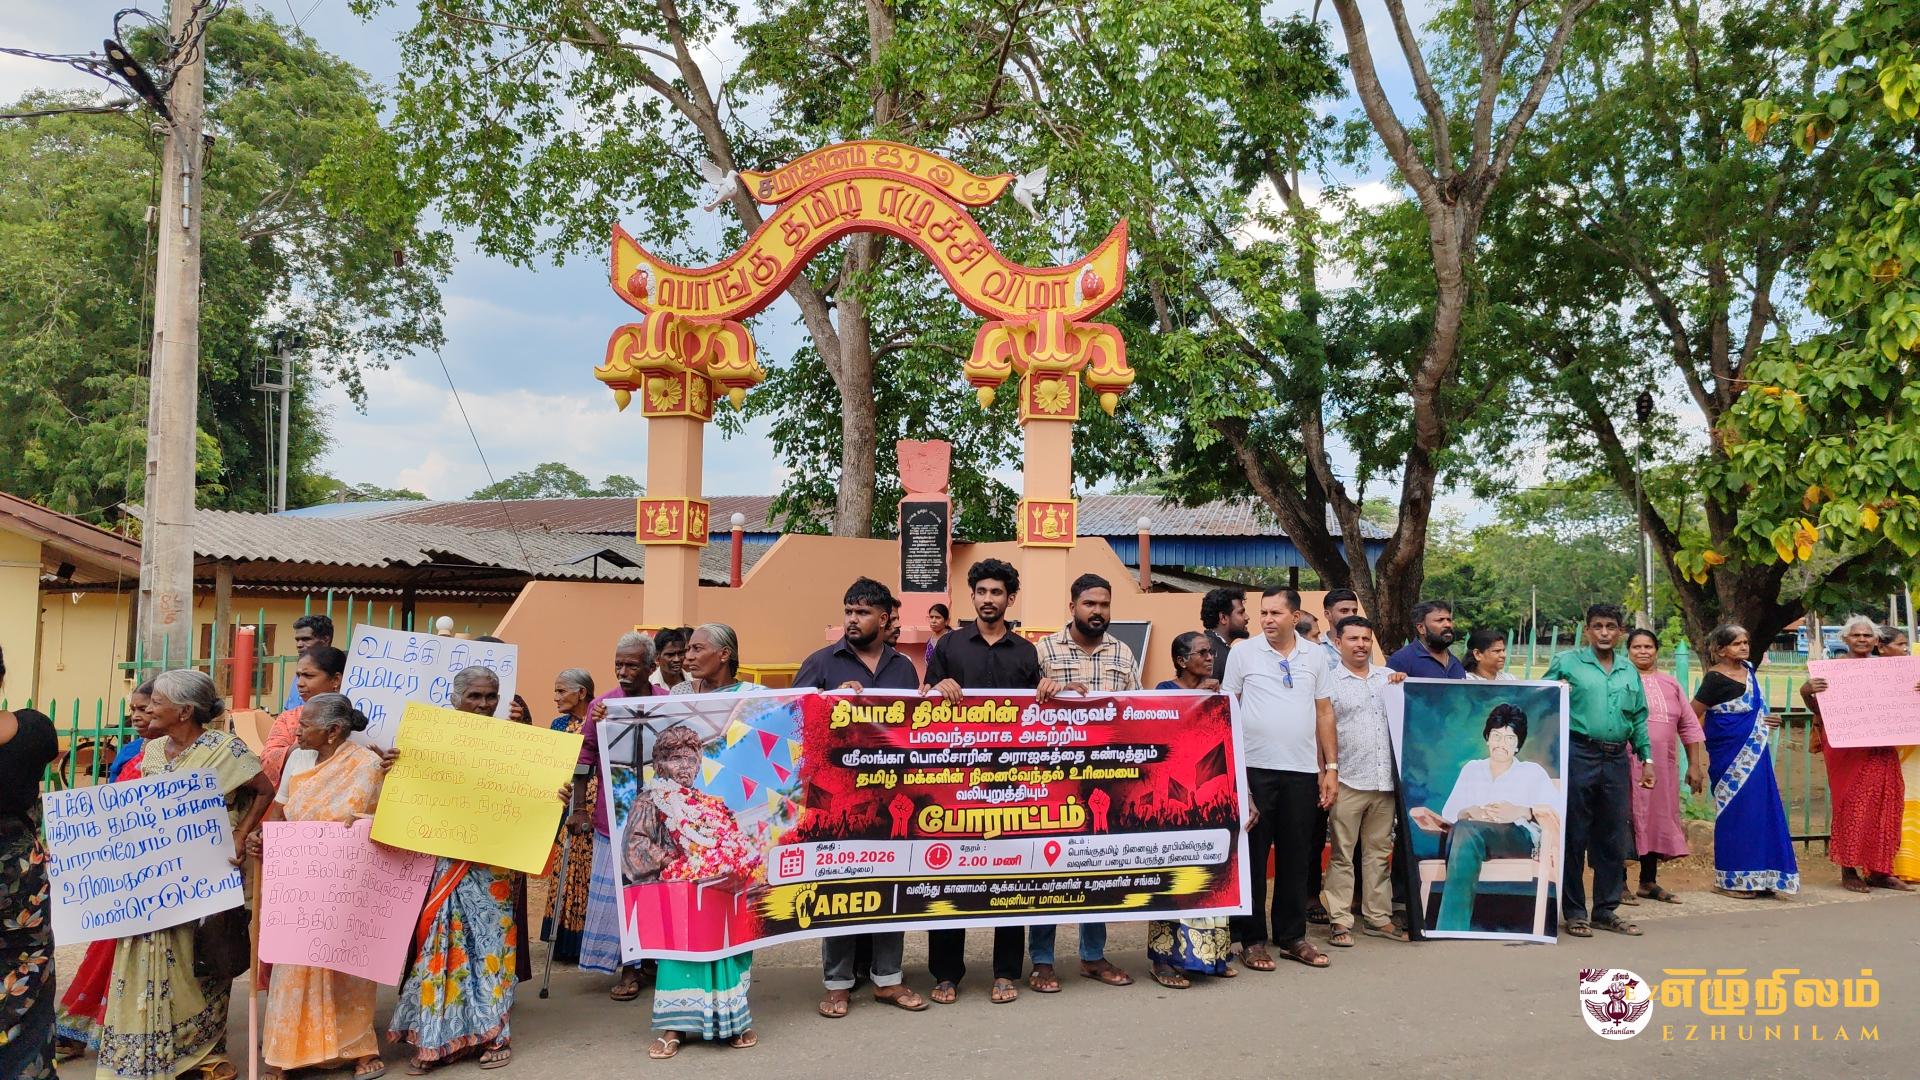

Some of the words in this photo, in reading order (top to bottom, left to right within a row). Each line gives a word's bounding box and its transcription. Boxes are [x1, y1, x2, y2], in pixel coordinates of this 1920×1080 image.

[658, 246, 782, 311] பொங்கு
[780, 179, 863, 255] தமிழ்
[878, 186, 989, 277] எழுச்சி
[980, 270, 1069, 312] விழா
[829, 699, 906, 729] தியாகி
[911, 699, 1019, 729] திலீபனின்
[1021, 702, 1117, 726] திருவுருவச்
[1122, 706, 1179, 721] சிலையை
[909, 727, 1012, 747] பலவந்தமாக
[1019, 726, 1087, 746] அகற்றிய
[910, 748, 992, 766] பொலீசாரின்
[998, 747, 1085, 765] அராஜகத்தை
[1090, 745, 1157, 763] கண்டித்தும்
[856, 769, 897, 789] தமிழ்
[903, 768, 964, 785] மக்களின்
[969, 765, 1064, 786] நினைவேந்தல்
[1069, 765, 1139, 780] உரிமையை
[956, 784, 1048, 803] வலியுறுத்தியும்
[108, 806, 156, 841] தமிழ்
[918, 795, 1086, 839] போராட்டம்
[177, 819, 222, 846] எமது
[816, 842, 835, 852] திகதி
[960, 844, 981, 853] நேரம்
[816, 851, 895, 866] 28.09.2026
[958, 856, 988, 867] 2.00
[992, 854, 1022, 866] மணி
[1105, 858, 1131, 868] பழைய
[1134, 855, 1165, 866] பேருந்து
[1167, 853, 1200, 865] நிலையம்
[1203, 853, 1221, 861] வரை
[906, 882, 941, 898] வலிந்து
[943, 881, 987, 894] காணாமல்
[990, 877, 1082, 893] ஆக்கப்பட்டவர்களின்
[1084, 875, 1131, 891] உறவுகளின்
[1133, 874, 1161, 887] சங்கம்
[990, 893, 1034, 909] வவுனியா
[1039, 891, 1085, 905] மாவட்டம்
[308, 937, 369, 968] வேண்டும்
